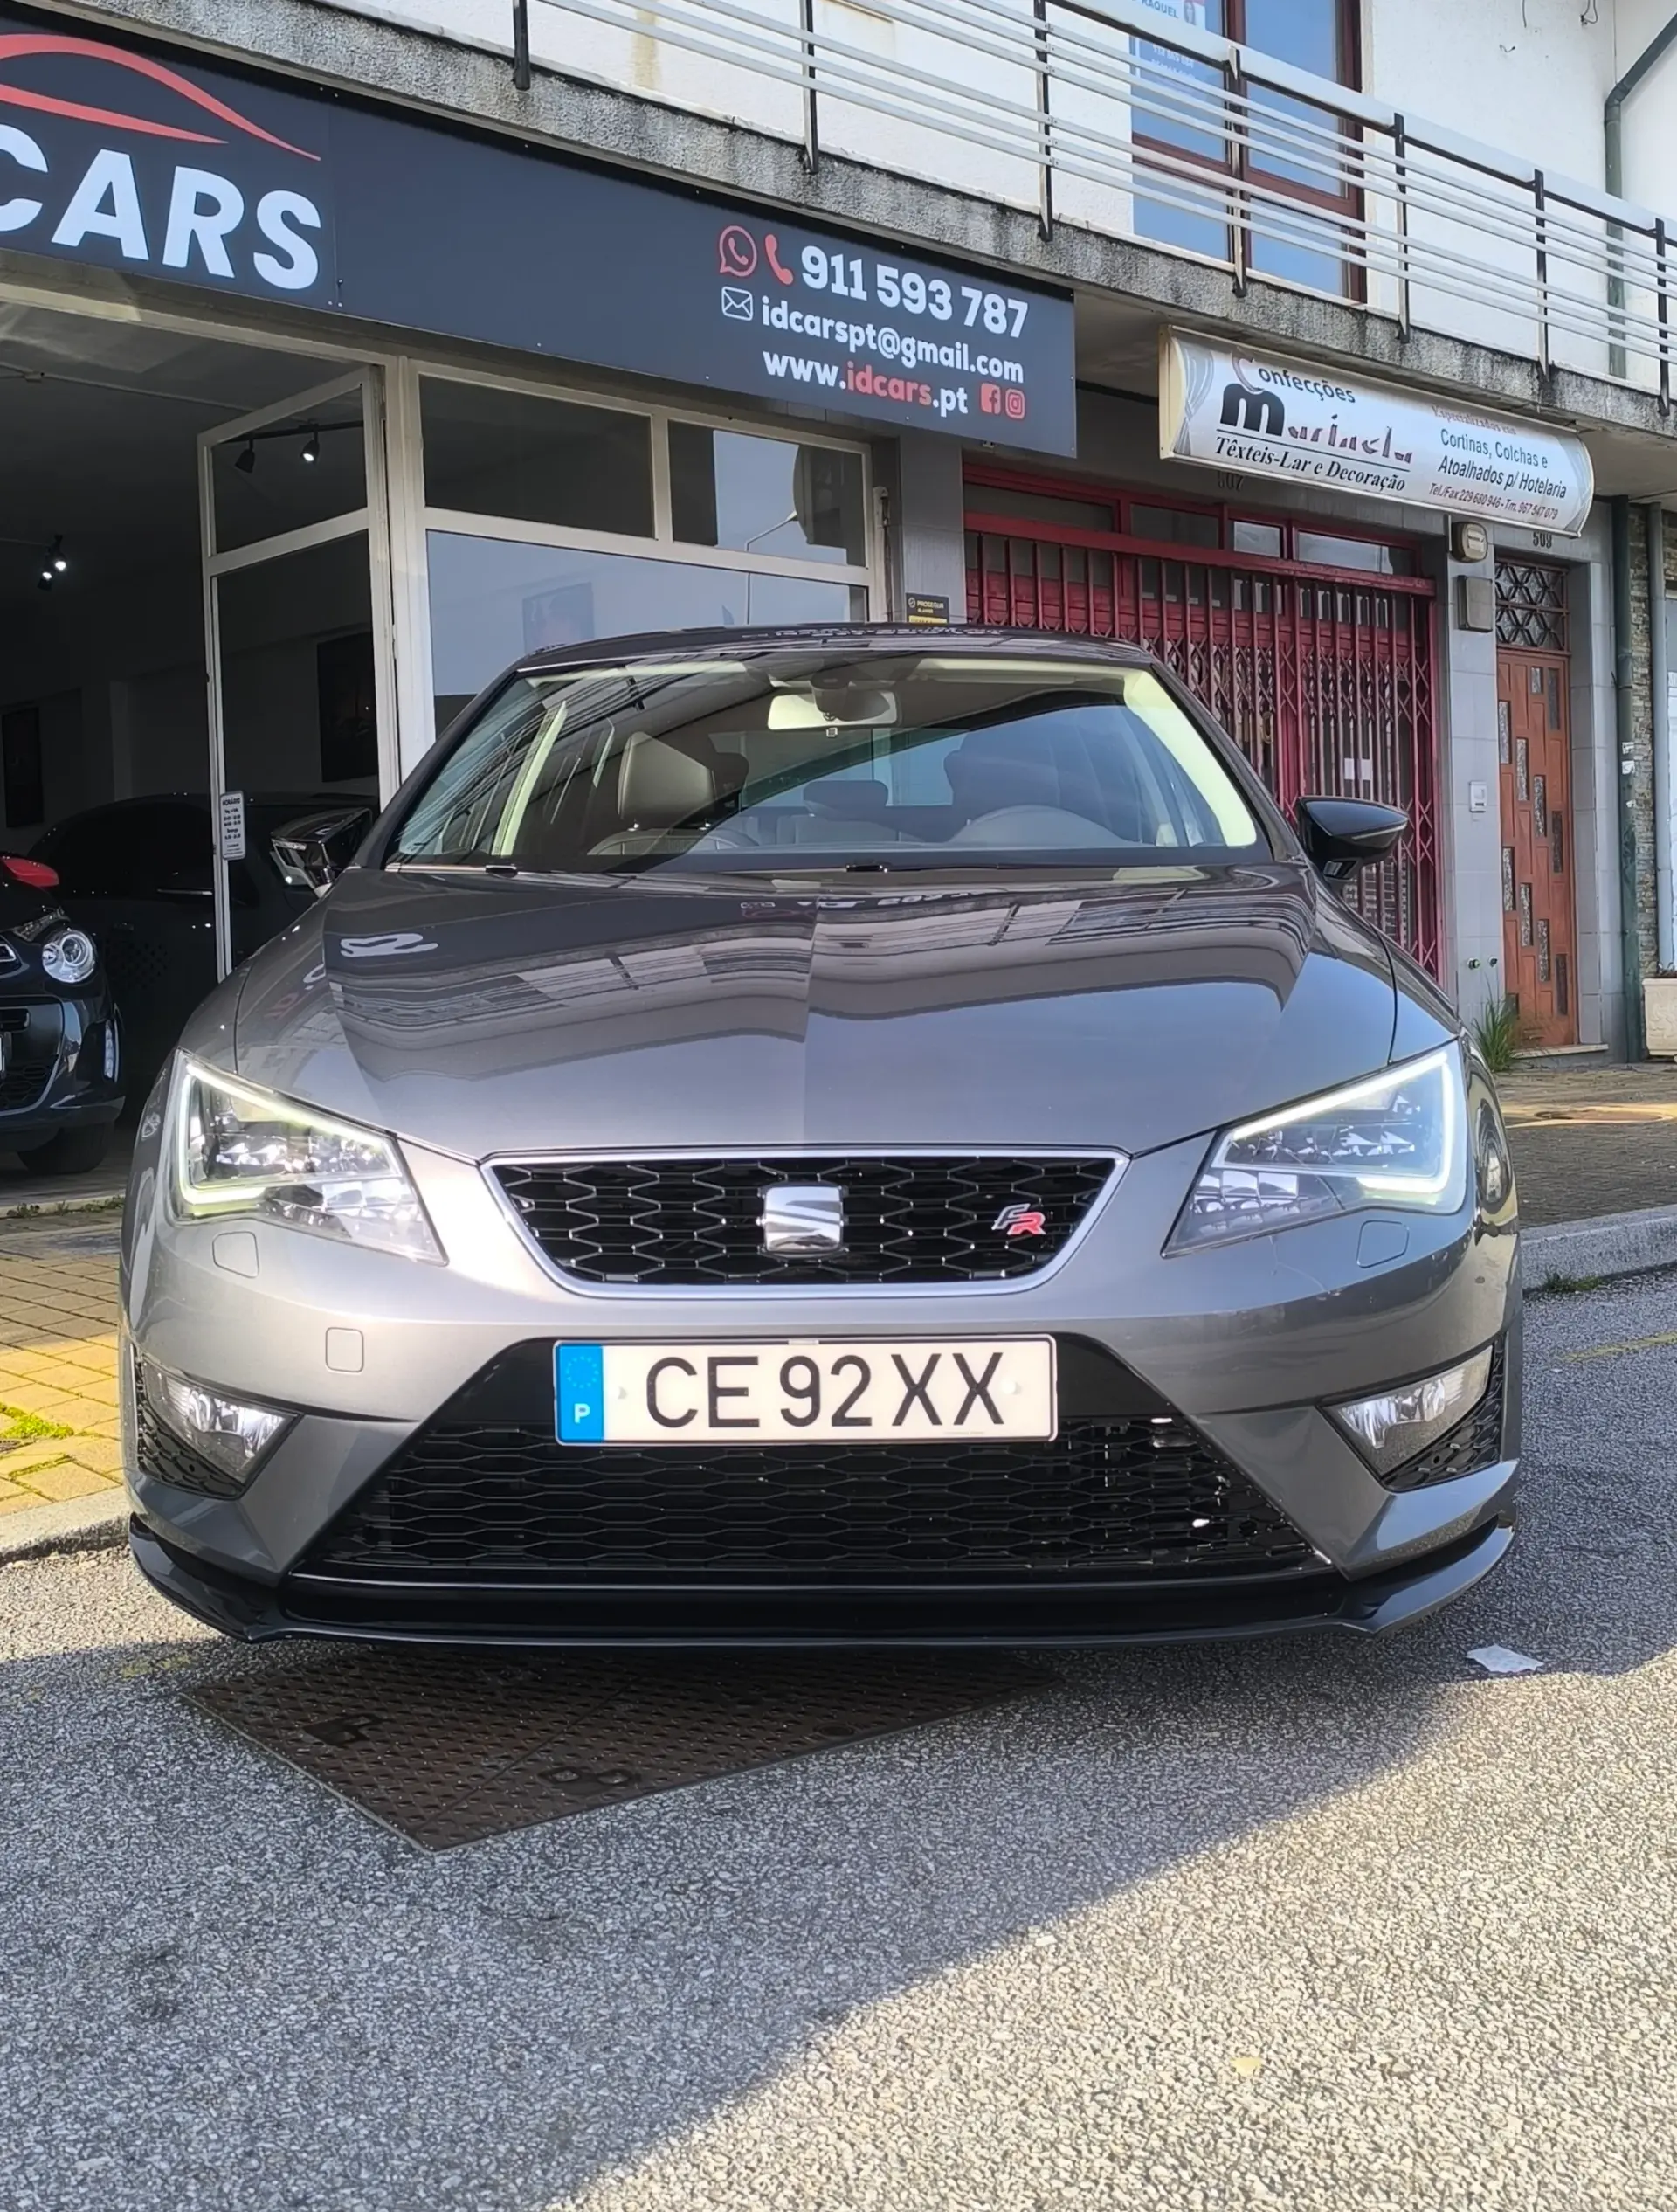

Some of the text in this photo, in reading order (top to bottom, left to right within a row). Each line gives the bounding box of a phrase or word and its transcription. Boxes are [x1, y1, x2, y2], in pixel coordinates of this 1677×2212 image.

[802, 245, 1028, 338] 911 593 787
[762, 296, 1024, 384] idcarspt@gmail.com
[763, 351, 969, 418] www.idcars.pt
[1231, 348, 1356, 404] Confecções
[1215, 436, 1406, 492] Têxteis-Lar e Decoração
[1440, 428, 1549, 469] Cortinas, Colchas e
[1438, 455, 1567, 500] Atoalhados p/ Hotelaria
[1460, 489, 1474, 504] 229
[1517, 501, 1532, 515] 967
[574, 1352, 1004, 1428] P CE 92 XX
